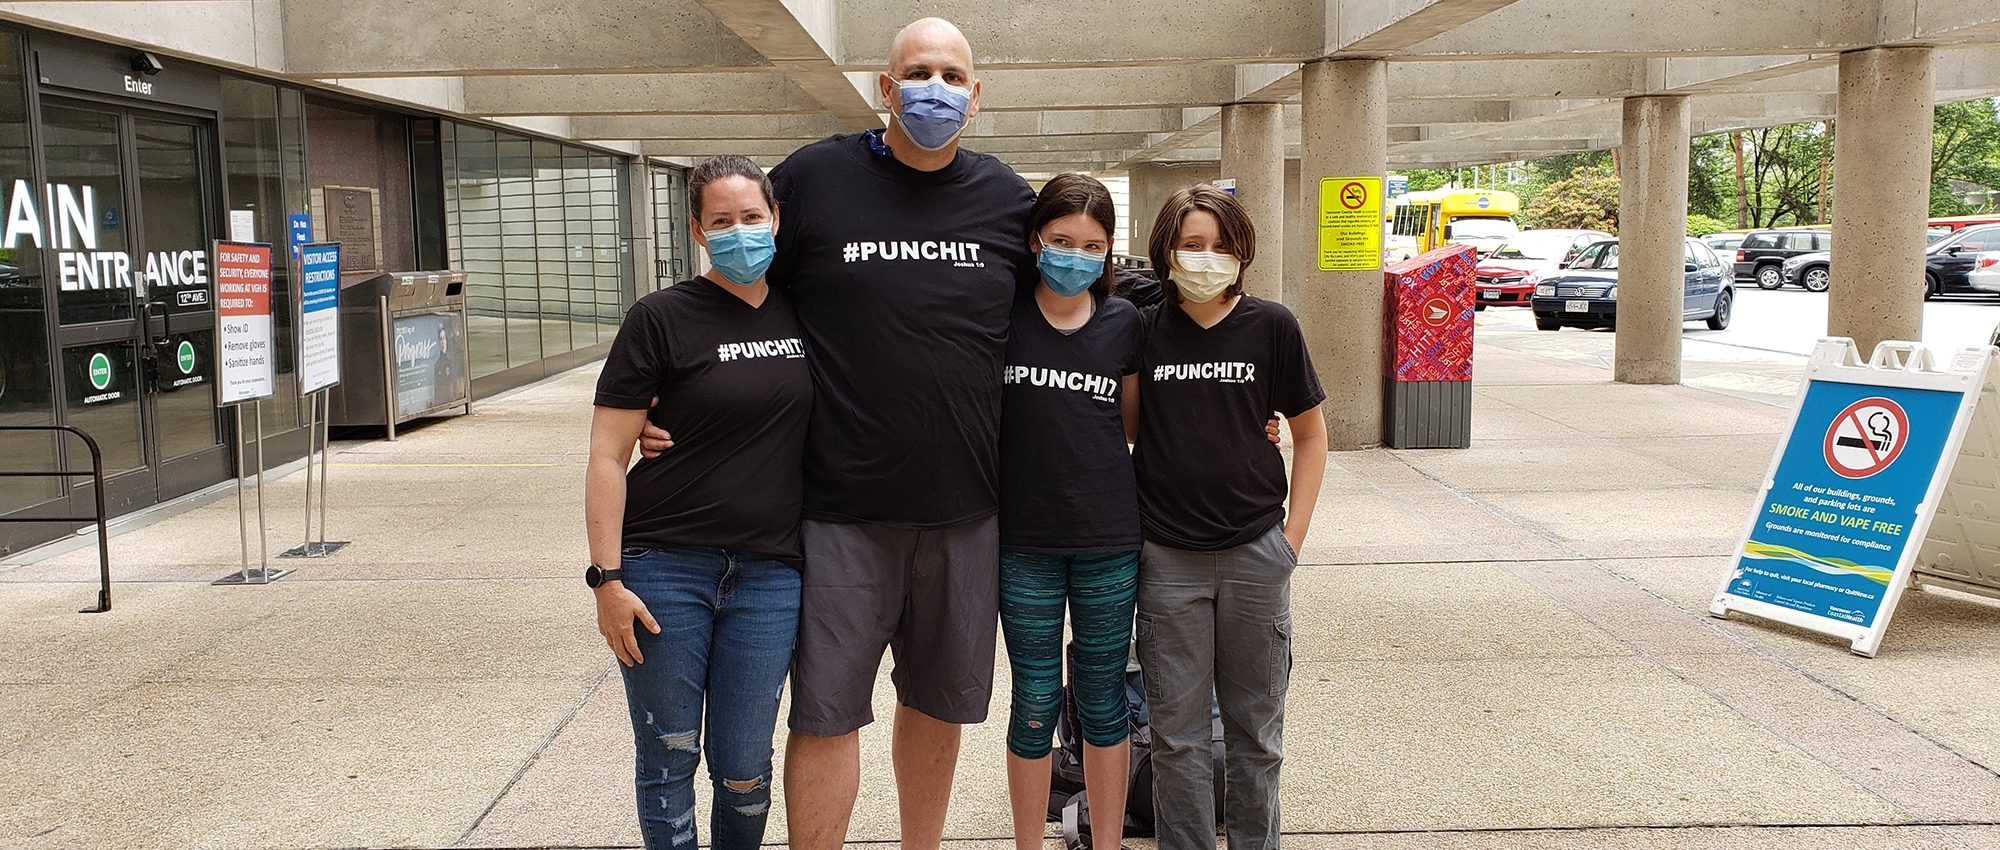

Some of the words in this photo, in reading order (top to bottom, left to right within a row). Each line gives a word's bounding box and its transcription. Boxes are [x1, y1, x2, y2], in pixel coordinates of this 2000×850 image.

[124, 75, 152, 95] Enter
[0, 178, 96, 249] AIN
[220, 252, 230, 262] FOR
[231, 253, 249, 263] SAFETY
[249, 254, 260, 264] AND
[304, 252, 321, 265] VISITOR
[322, 251, 337, 264] ACCESS
[843, 240, 980, 262] #PUNCHIT
[58, 250, 207, 291] ENTRANCE
[220, 268, 243, 279] SECURITY,
[244, 269, 269, 278] EVERYONE
[306, 269, 335, 284] RESTRICTIONS
[220, 283, 244, 293] WORKING
[245, 284, 252, 292] AT
[252, 284, 261, 292] VGH
[262, 284, 267, 292] IS
[1439, 278, 1450, 288] J5T
[180, 293, 192, 304] 12TH
[192, 292, 204, 303] AVE.
[220, 298, 244, 309] REQUIRED
[245, 298, 253, 308] TO:
[227, 324, 241, 334] Show
[243, 323, 249, 333] ID
[228, 341, 248, 351] Remove
[250, 339, 265, 351] gloves
[395, 334, 436, 367] Progress
[718, 338, 801, 362] #PUNCHIT
[1410, 335, 1432, 358] H1T
[1453, 337, 1471, 356] R7N
[228, 356, 248, 368] Sanitize
[249, 355, 264, 366] hands
[1442, 358, 1453, 368] J5T
[1444, 349, 1458, 364] V7J
[93, 368, 107, 376] ENTER
[1154, 362, 1245, 381] #PUNCHIT
[1428, 366, 1442, 379] G3N
[173, 377, 192, 387] AUTOMATIC
[1004, 365, 1117, 397] #PUNCHIT
[84, 394, 108, 404] AUTOMATIC
[108, 392, 120, 400] DOOR
[1792, 482, 1802, 490] All
[1826, 488, 1862, 501] buildings,
[1862, 494, 1896, 507] grounds,
[1804, 495, 1818, 504] and
[1818, 498, 1846, 510] parking
[1847, 502, 1861, 511] lots
[1769, 503, 1810, 519] SMOKE
[1810, 510, 1838, 524] AND
[1840, 516, 1871, 530] VAPE
[1872, 521, 1903, 536] FREE
[1766, 521, 1792, 532] Grounds
[1805, 529, 1840, 542] monitored
[1840, 535, 1851, 543] for
[1852, 538, 1891, 551] compliance
[1813, 582, 1838, 592] pharmacy
[1845, 588, 1874, 599] QuitNow.ca
[1830, 606, 1851, 614] Vancouver
